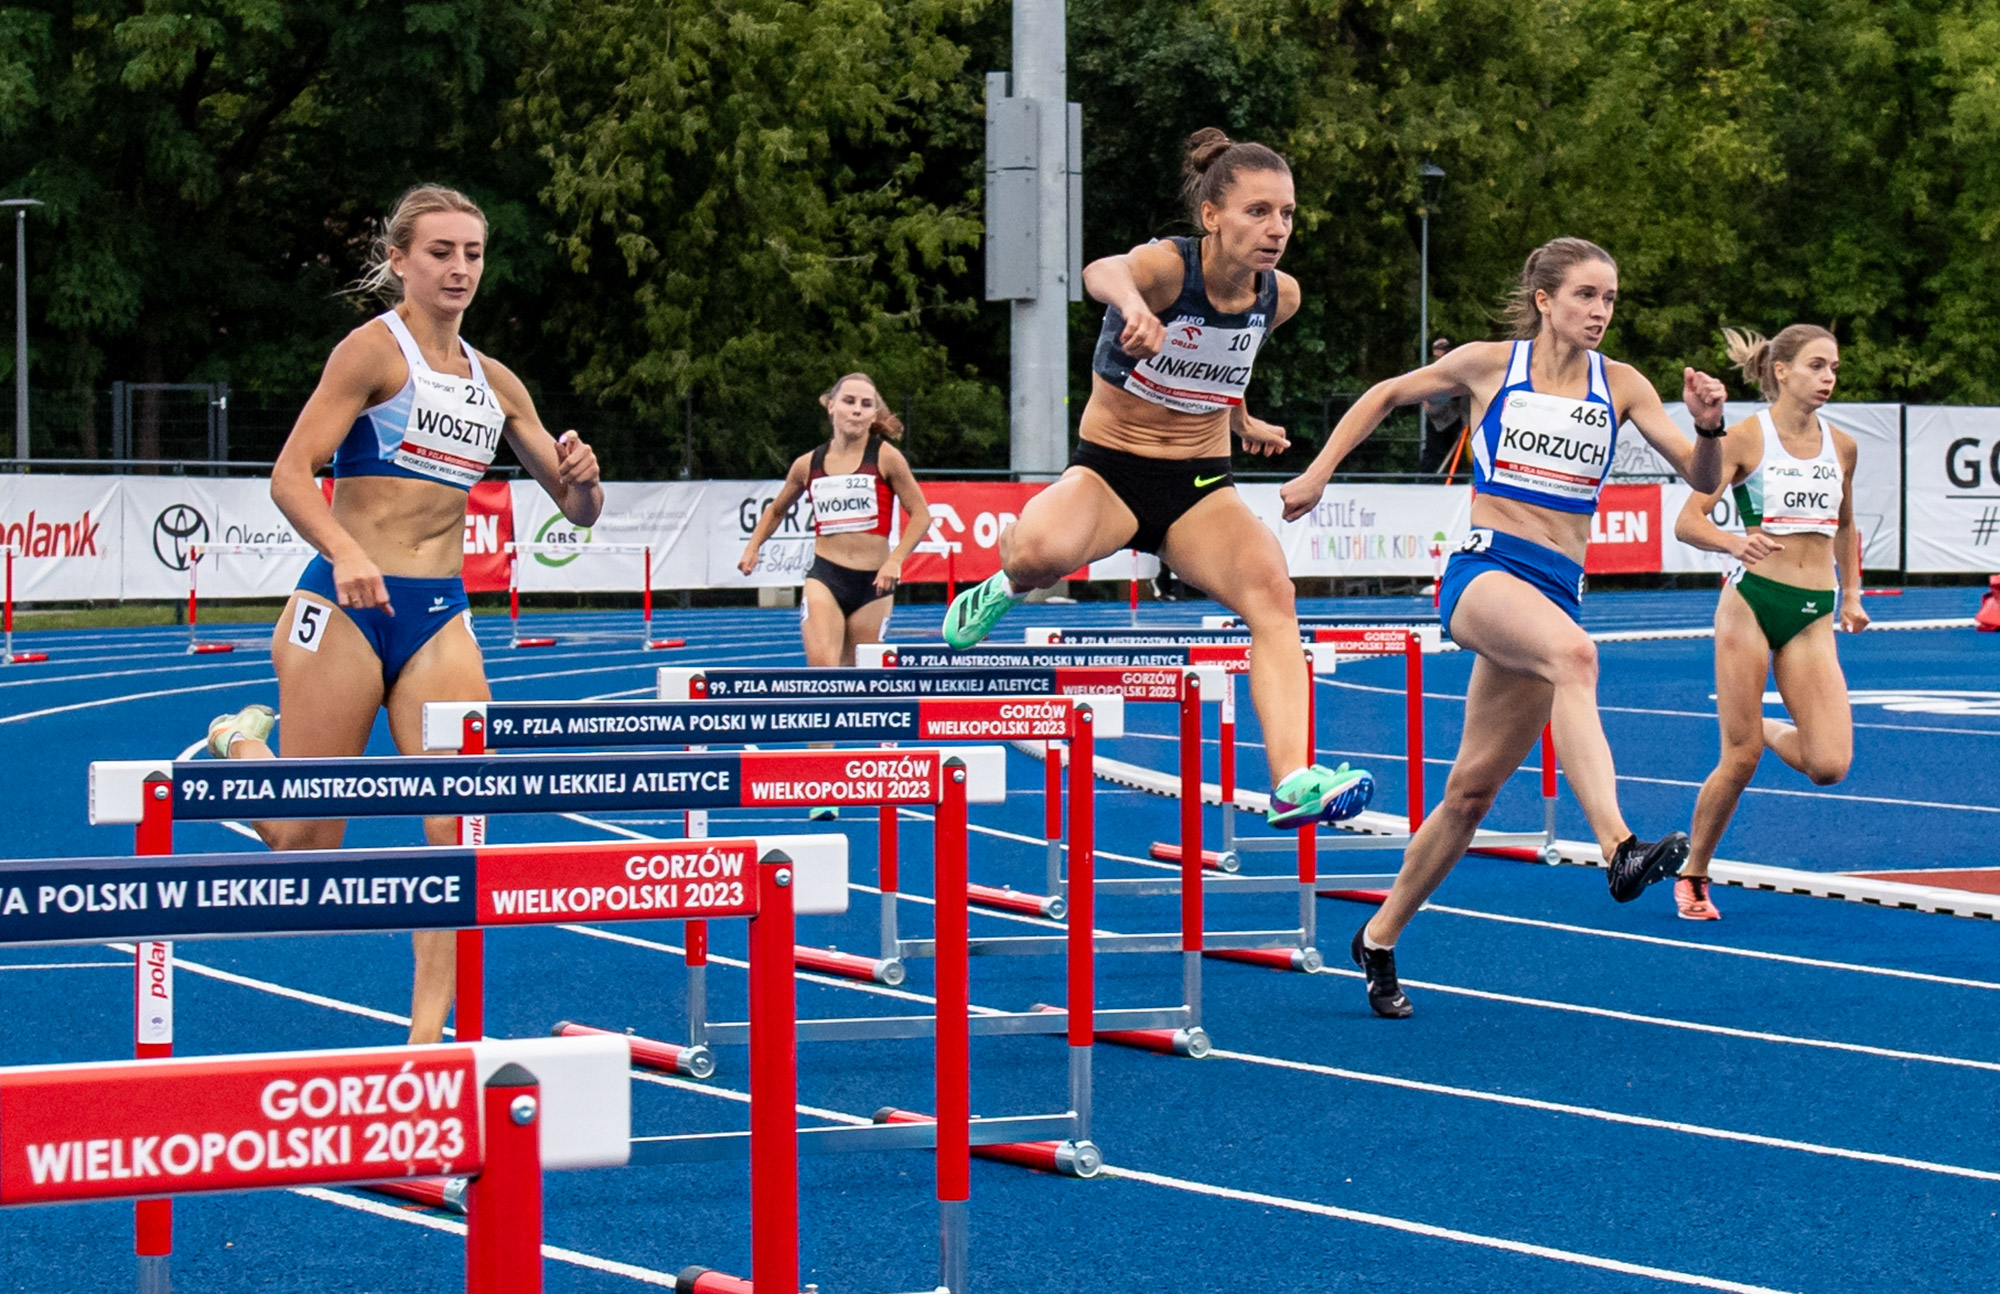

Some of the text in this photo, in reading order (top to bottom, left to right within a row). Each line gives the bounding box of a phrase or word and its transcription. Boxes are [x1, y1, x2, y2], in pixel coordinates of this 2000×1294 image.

[1175, 314, 1205, 326] JAKO
[1171, 338, 1199, 350] ORLEN
[1228, 333, 1250, 351] 10
[1570, 406, 1608, 428] 465
[1503, 427, 1606, 466] KORZUCH
[1812, 465, 1837, 480] 204
[845, 478, 868, 489] 323
[817, 496, 871, 513] WÓJCIK
[1783, 491, 1829, 509] GRYC
[0, 509, 101, 558] olanik
[1588, 510, 1648, 543] LEN
[547, 532, 578, 544] GBS
[1311, 534, 1426, 560] HEALTHIER KIDS
[298, 605, 321, 643] 5
[900, 655, 919, 667] 99.
[921, 655, 948, 667] PZLA
[951, 655, 1029, 667] MISTRZOSTWA
[1030, 655, 1071, 667] POLSKI
[1073, 655, 1086, 666] W
[1088, 655, 1129, 666] LEKKIEJ
[1131, 654, 1184, 666] ATLETYCE
[709, 678, 1050, 695] 99. PZLA MISTRZOSTWA POLSKI W LEKKIEJ ATLETYCE
[1122, 670, 1177, 685] GORZÓW
[1149, 685, 1177, 698] 2023
[1000, 701, 1067, 719] GORZÓW
[493, 712, 911, 735] 99. PZLA MISTRZOSTWA POLSKI W LEKKIEJ ATLETYCE
[927, 719, 1067, 736] WIELKOPOLSKI 2023
[845, 755, 931, 778] GORZÓW
[181, 770, 730, 801] 99. PZLA MISTRZOSTWA POLSKI W LEKKIEJ ATLETYCE
[751, 779, 931, 800] WIELKOPOLSKI 2023
[625, 848, 744, 881] GORZÓW
[38, 882, 147, 914] POLSKI
[157, 881, 187, 909] W
[197, 878, 310, 908] LEKKIEJ
[318, 875, 460, 905] ATLETYCE
[491, 881, 744, 915] WIELKOPOLSKI 2023
[260, 1061, 466, 1120] GORZÓW
[26, 1118, 466, 1185] WIELKOPOLSKI 2023
